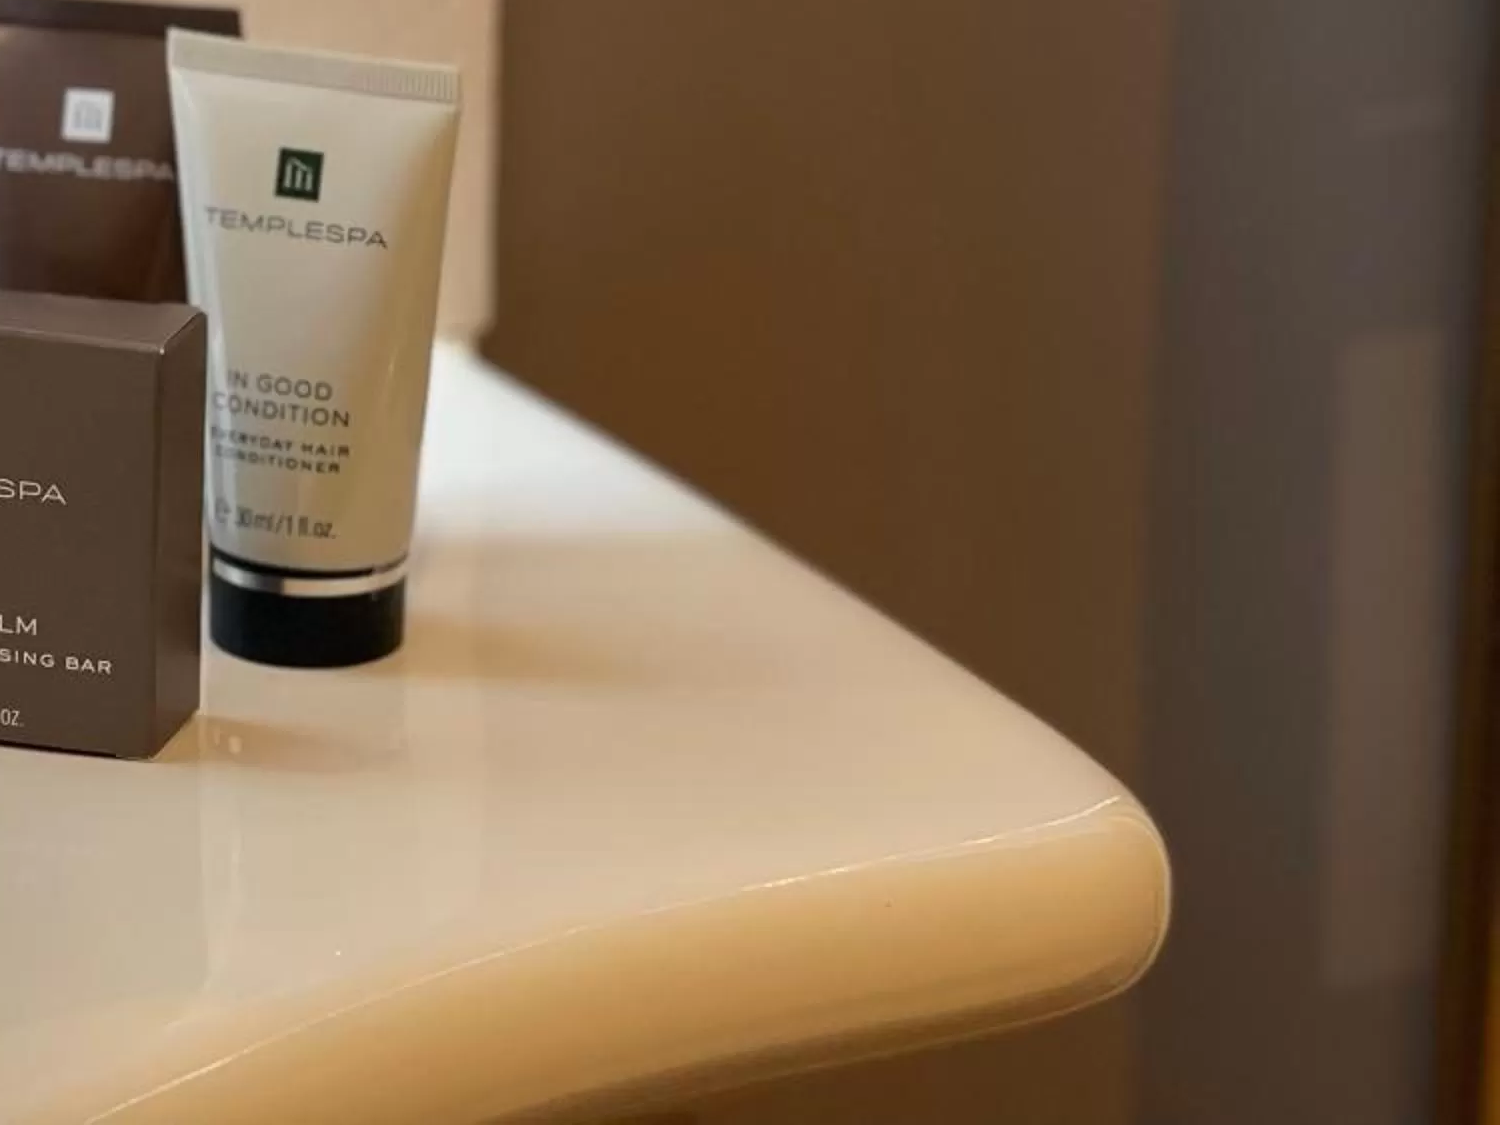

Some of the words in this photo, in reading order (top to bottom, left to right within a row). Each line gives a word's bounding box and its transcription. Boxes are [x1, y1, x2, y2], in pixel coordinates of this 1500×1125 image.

[205, 206, 389, 249] TEMPLESPA
[227, 369, 249, 389] IN
[256, 372, 333, 401] GOOD
[212, 390, 350, 427] CONDITION
[301, 442, 350, 458] HAIR
[65, 656, 113, 675] BAR
